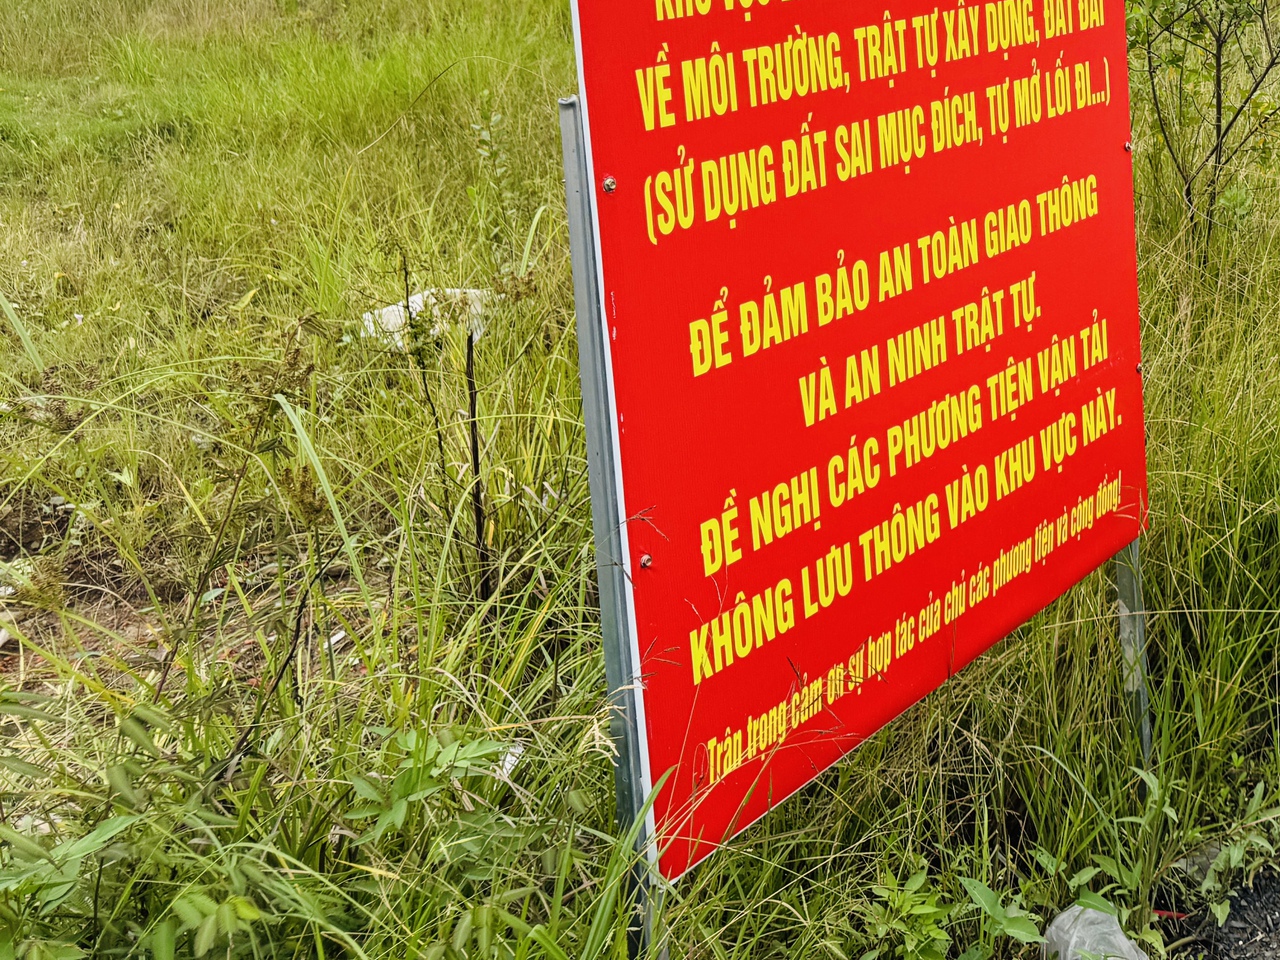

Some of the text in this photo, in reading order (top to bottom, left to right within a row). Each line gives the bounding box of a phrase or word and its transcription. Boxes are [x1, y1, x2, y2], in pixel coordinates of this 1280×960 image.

[635, 43, 676, 131] VỀ
[681, 41, 738, 122] MÔI
[742, 25, 850, 107] TRƯỜNG,
[854, 10, 907, 88] TRẬT
[912, 8, 938, 77] TỰ
[644, 50, 1110, 245] (SỬ DỤNG ĐẤT SAI MỤC ĐÍCH, TỰ MỞ LỐI ĐI...)
[689, 174, 1098, 377] ĐỂ ĐẢM BẢO AN TOÀN GIAO THÔNG
[799, 271, 1041, 427] VÀ AN NINH TRẬT TỰ.
[688, 387, 1122, 686] KHÔNG LƯU THÔNG VÀO KHU VỰC NÀY.
[700, 308, 1109, 577] ĐỀ NGHỊ CÁC PHƯƠNG TIỆN VẬN TẢI
[707, 470, 1122, 784] Trân trọng cảm ơn sự hợp tác của chủ các phương tiện và cộng đồng!
